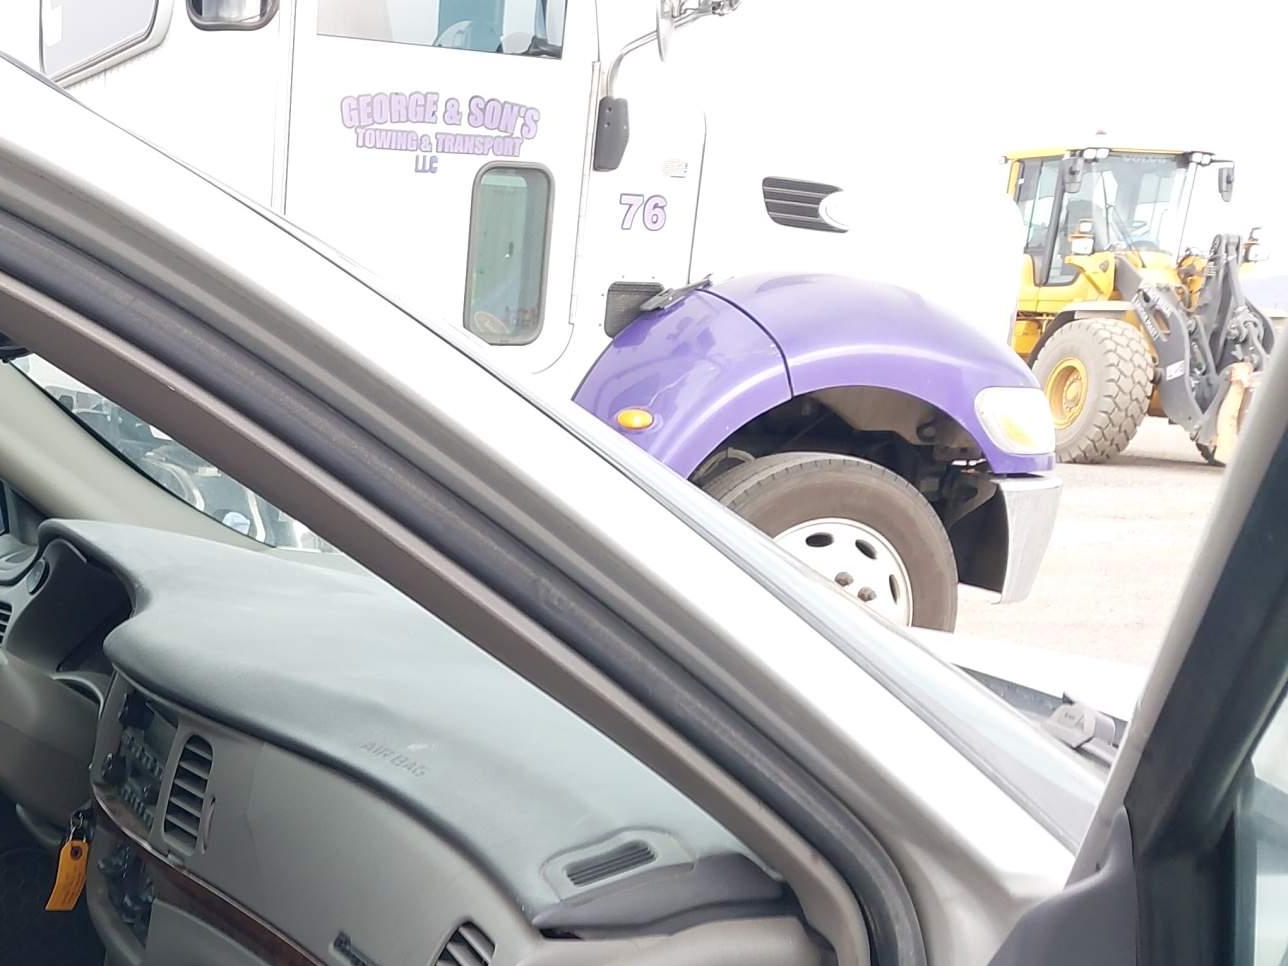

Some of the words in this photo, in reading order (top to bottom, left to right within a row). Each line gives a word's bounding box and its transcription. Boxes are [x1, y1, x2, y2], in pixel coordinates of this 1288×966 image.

[341, 91, 439, 128] GEORGE
[443, 97, 462, 126] &
[468, 95, 541, 139] SON'S
[355, 128, 418, 152] TOWING
[419, 134, 432, 152] &
[435, 132, 523, 157] TRANSPORT
[415, 154, 439, 173] LLC
[619, 192, 668, 232] 76
